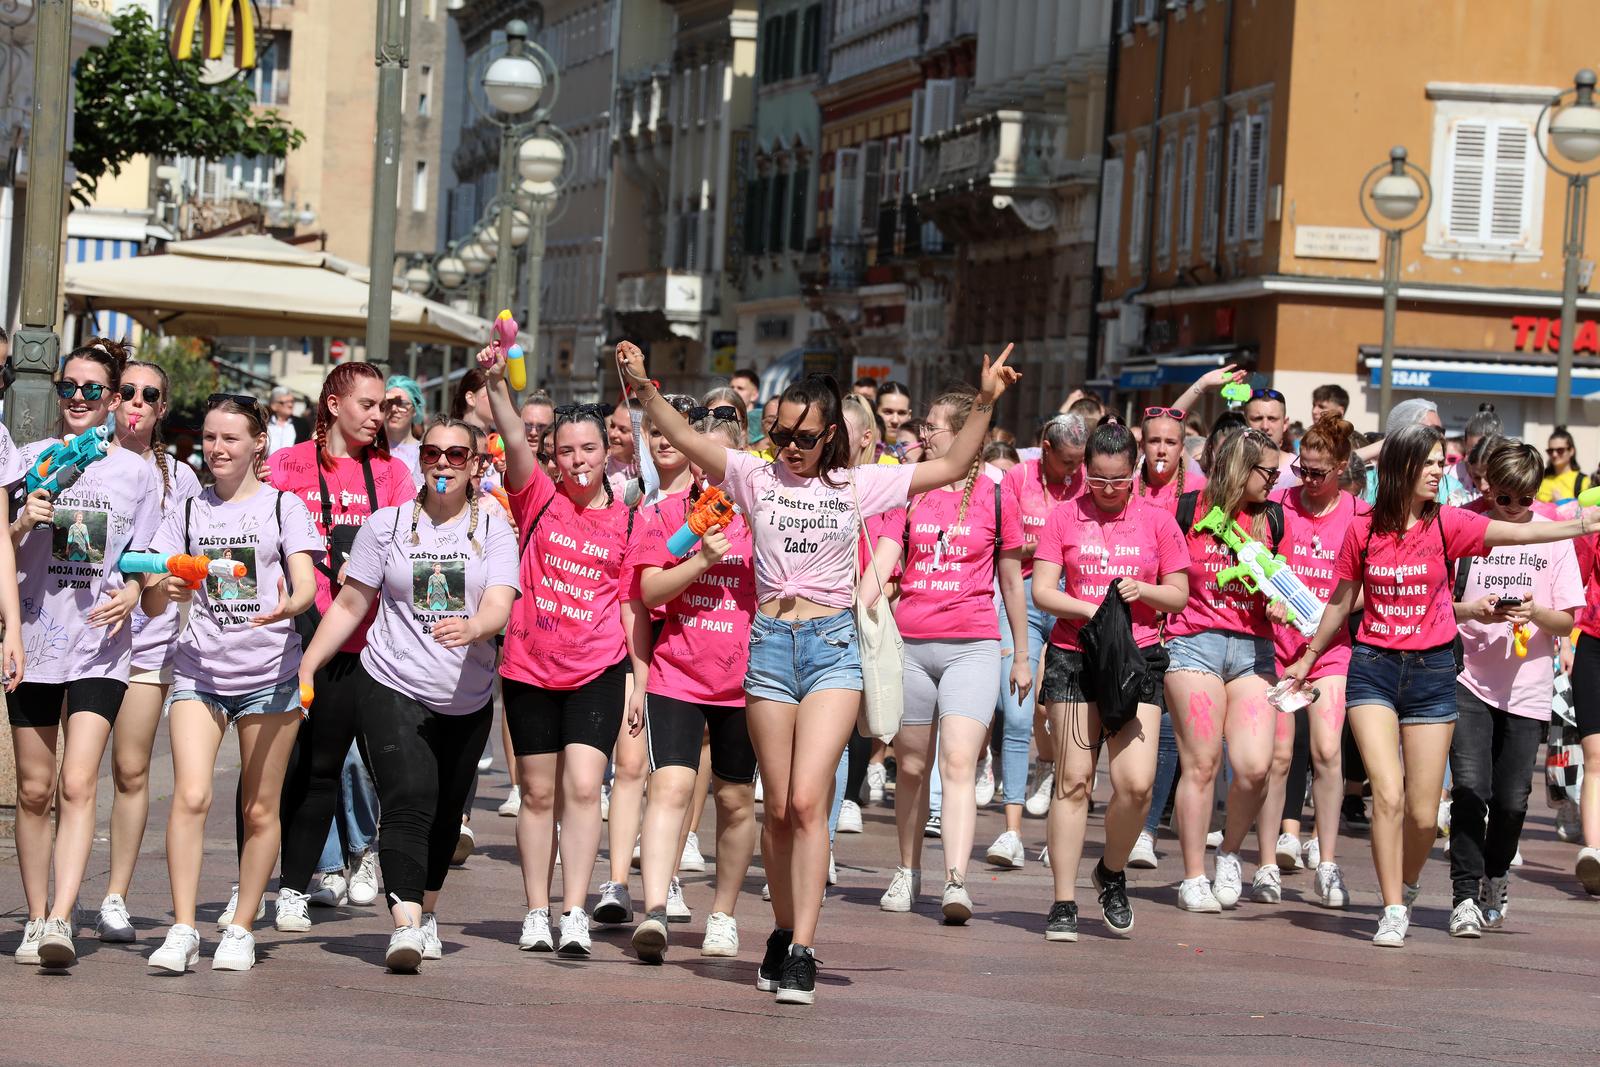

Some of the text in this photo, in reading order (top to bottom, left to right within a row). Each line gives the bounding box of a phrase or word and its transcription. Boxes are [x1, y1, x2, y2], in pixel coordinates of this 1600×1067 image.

[307, 491, 336, 504] KAA
[777, 495, 815, 511] sestre
[82, 498, 101, 509] BAŠ
[102, 501, 113, 512] TI,
[769, 510, 838, 533] i gospodin
[1022, 515, 1046, 527] KADA
[915, 523, 940, 534] KADA
[198, 534, 260, 546] ZAŠTO BAŠ TI,
[549, 531, 610, 560] KADA ŽENE
[784, 537, 818, 553] Zadro
[409, 551, 470, 560] ZAŠTO BAŠ TI,
[1114, 544, 1140, 557] ŽENE
[544, 552, 602, 581] TULUMARE
[950, 562, 961, 572] SE
[1482, 553, 1516, 565] sestre
[1520, 552, 1548, 571] Helge
[48, 565, 103, 578] MOJA IKONO
[1080, 564, 1140, 576] TULUMARE
[1368, 565, 1396, 577] KADA
[58, 579, 91, 589] SA ZIDA
[931, 580, 960, 591] PRAVE
[1477, 572, 1532, 589] i gospodin
[582, 589, 595, 602] SE
[230, 603, 260, 613] IKONO
[535, 596, 593, 622] ZUBI PRAVE
[724, 599, 736, 611] SE
[1415, 605, 1427, 616] SE
[701, 618, 733, 633] PRAVE
